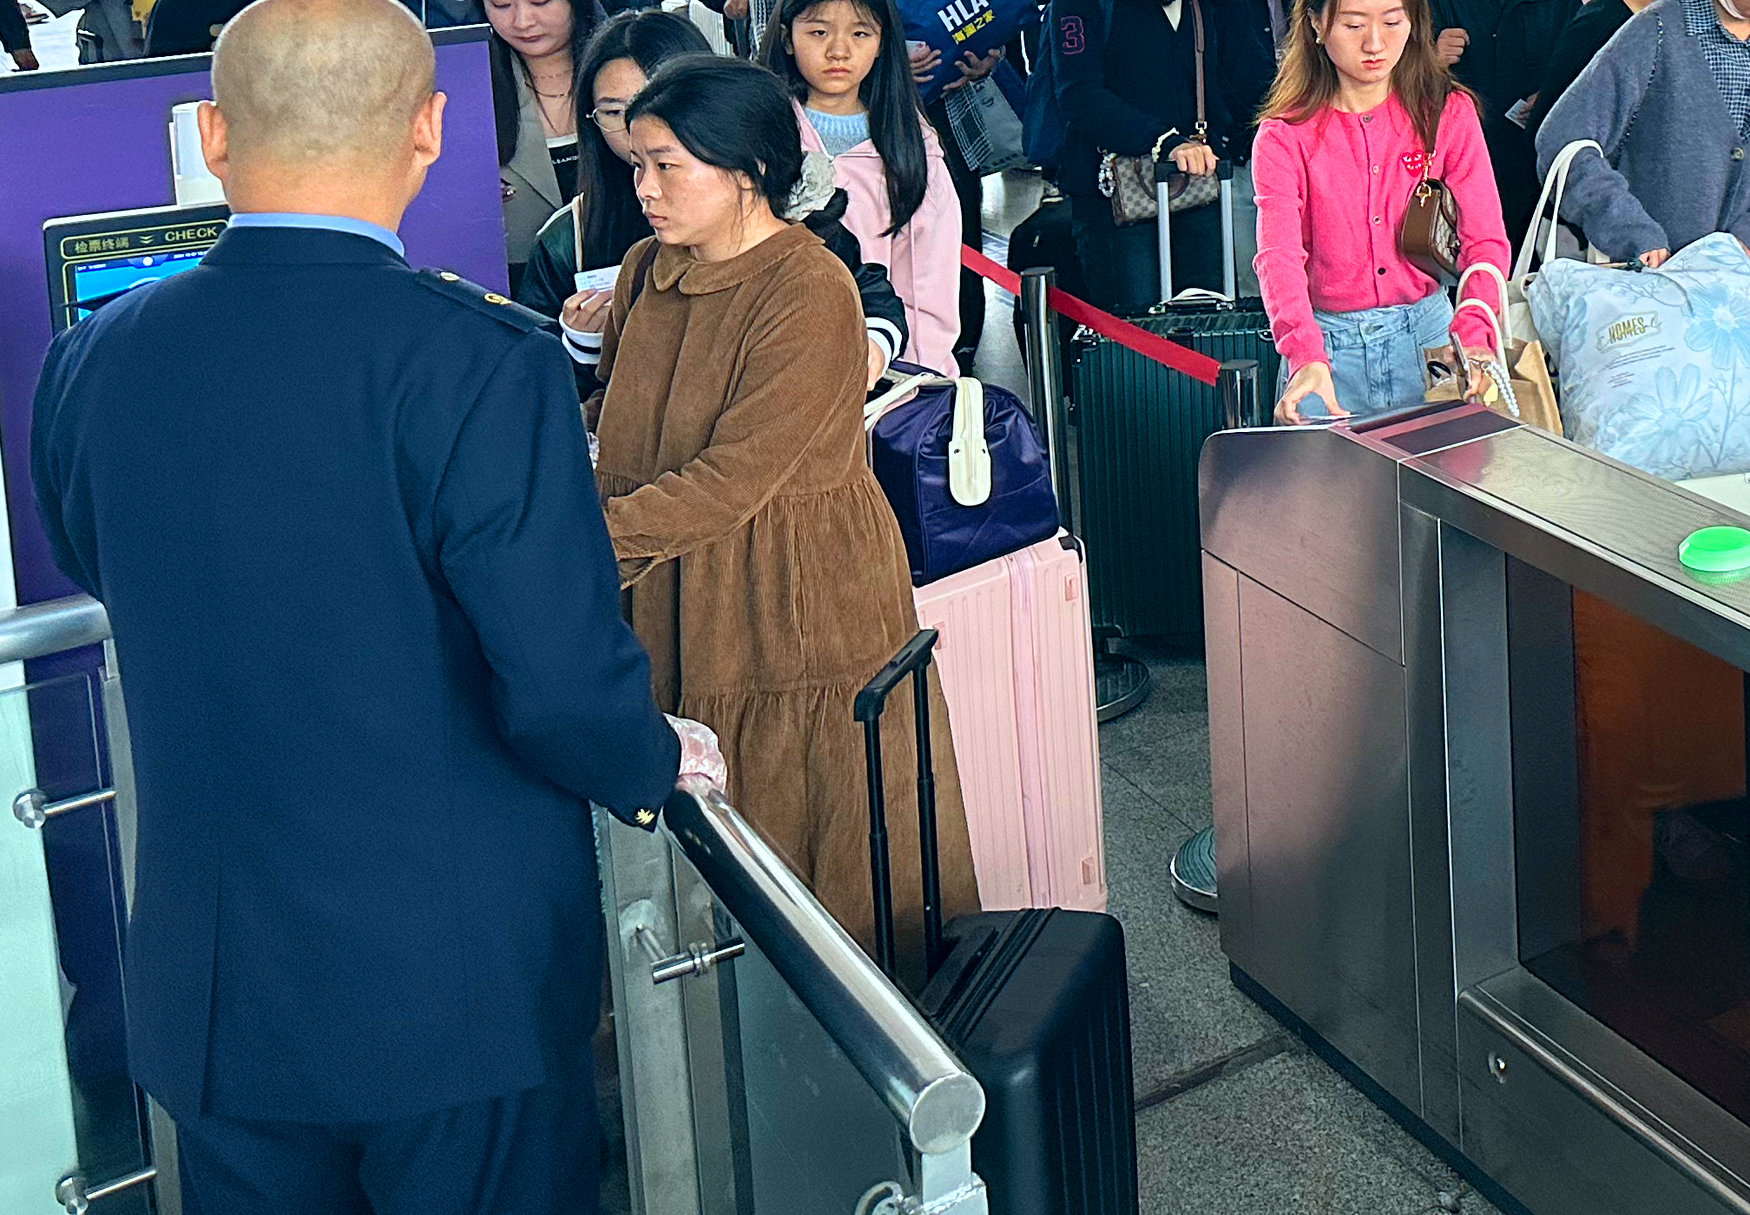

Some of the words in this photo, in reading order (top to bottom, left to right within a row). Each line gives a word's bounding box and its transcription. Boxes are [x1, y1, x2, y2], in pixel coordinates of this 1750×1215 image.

[1060, 15, 1085, 55] 3
[165, 226, 217, 242] CHECK
[75, 237, 129, 254] 检票终端
